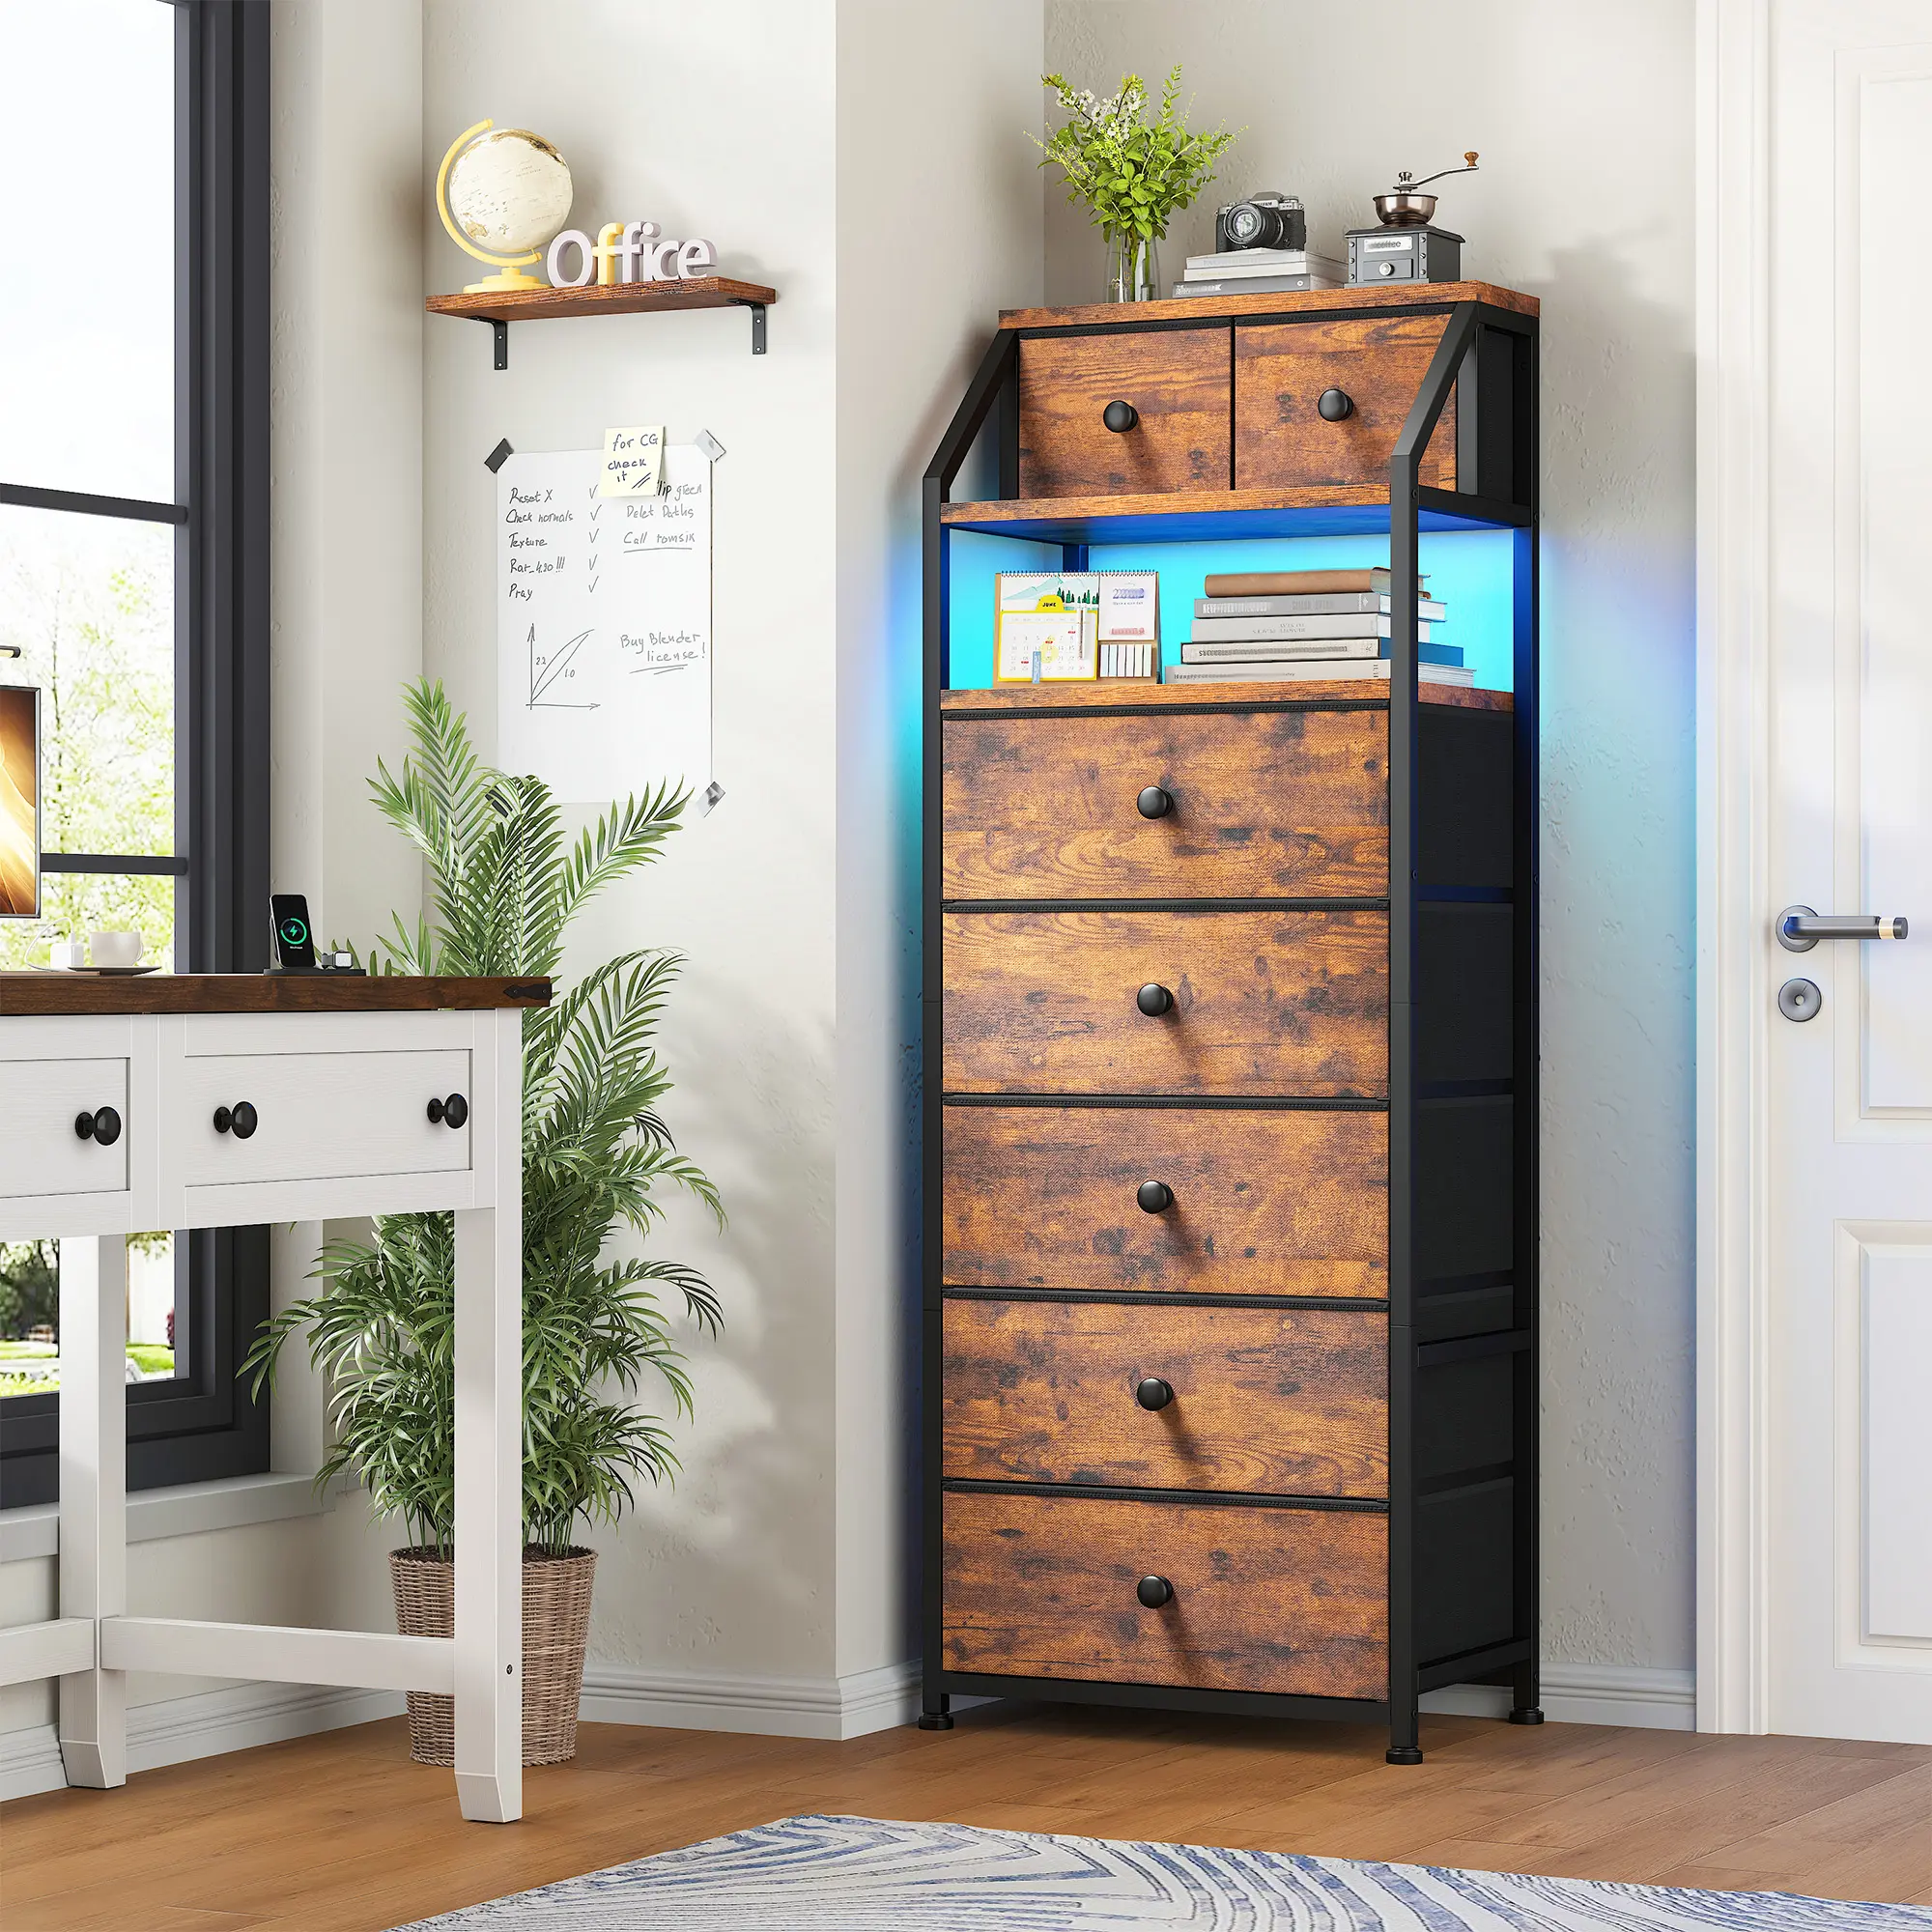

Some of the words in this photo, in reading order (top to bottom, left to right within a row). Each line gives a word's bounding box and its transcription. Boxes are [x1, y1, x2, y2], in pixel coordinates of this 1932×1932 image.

[547, 221, 718, 289] Office
[612, 433, 635, 452] for
[639, 433, 659, 446] CG
[608, 458, 647, 470] check
[616, 470, 628, 483] it
[509, 487, 541, 504] Reset
[544, 489, 554, 503] X
[654, 480, 672, 503] lip
[505, 509, 532, 524] Check
[538, 509, 574, 523] normals
[626, 504, 654, 519] Delet
[508, 531, 548, 549] Texture
[623, 531, 648, 545] Call
[508, 582, 533, 602] Pray
[619, 634, 644, 655] Buy
[649, 630, 701, 646] Blender
